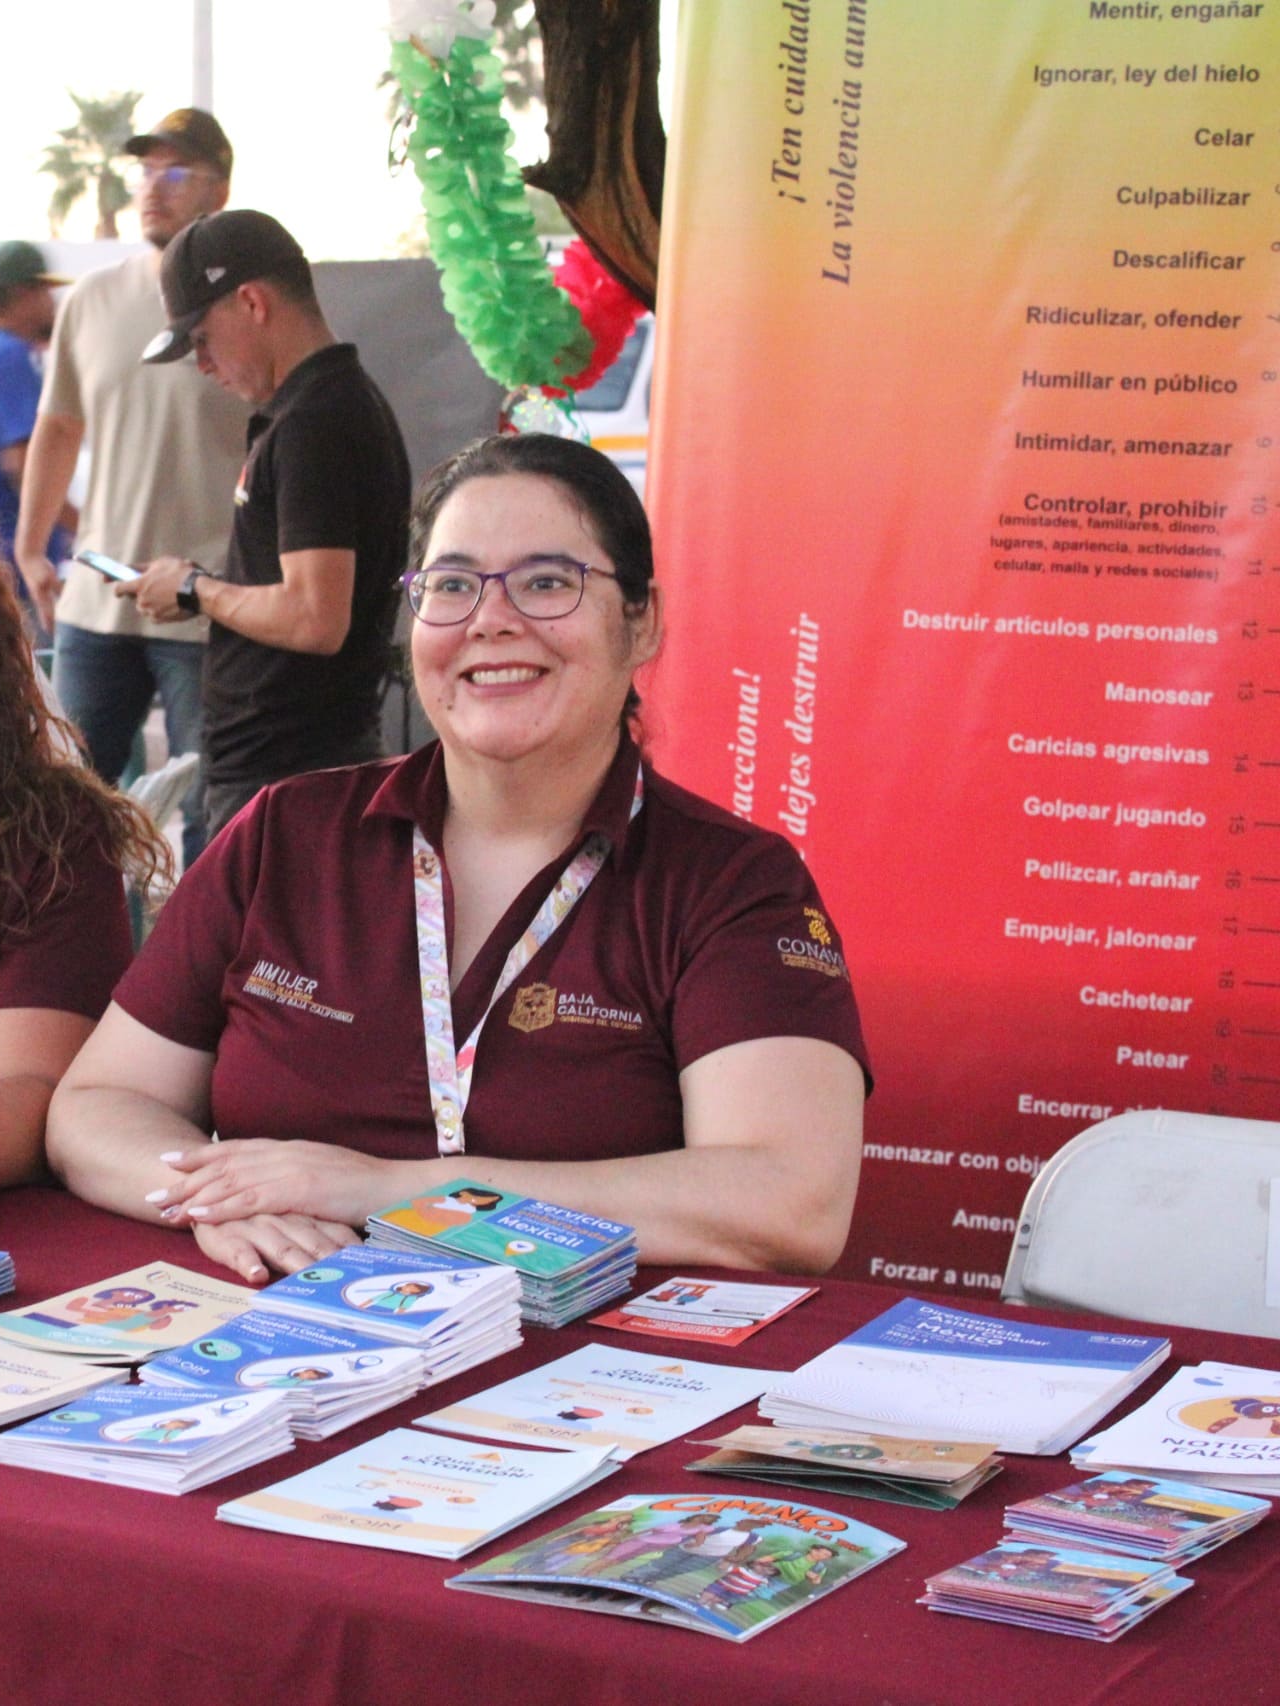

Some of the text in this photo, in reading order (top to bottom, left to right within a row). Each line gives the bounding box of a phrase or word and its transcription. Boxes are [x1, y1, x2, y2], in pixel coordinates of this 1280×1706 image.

[1089, 1, 1264, 23] Mentir, engañar
[1033, 65, 1261, 87] Ignorar, ley del hielo
[771, 0, 810, 204] ¡Ten cuidad
[1194, 128, 1254, 147] Celar
[826, 80, 862, 229] violencia
[1116, 185, 1251, 210] Culpabilizar
[821, 241, 852, 286] La
[1113, 249, 1245, 270] Descalificar
[1026, 306, 1242, 330] Ridiculizar, ofender
[1022, 369, 1238, 397] Humillar en público
[1014, 432, 1233, 457] Intimidar, amenazar
[1023, 493, 1228, 519] Controlar, prohibir
[1095, 565, 1103, 577] y
[1107, 563, 1149, 577] redes
[902, 609, 1219, 644] Destruir artículos personales
[1104, 682, 1214, 706] Manosear
[778, 612, 820, 836] dejes destruir
[1007, 733, 1210, 764] Caricias agresivas
[1023, 796, 1207, 828] Golpear jugando
[1024, 858, 1201, 890] Pellizcar, arañar
[1004, 917, 1198, 951] Empujar, jalonear
[251, 959, 319, 994] INMUJER
[558, 992, 595, 1006] BAJA
[1079, 986, 1194, 1012] Cachetear
[557, 1005, 643, 1024] CALIFORNIA
[1115, 1046, 1190, 1069] Patear
[959, 1153, 999, 1170] con
[534, 1201, 624, 1234] Servicios
[497, 1215, 584, 1248] Mexicali
[870, 1256, 1002, 1289] Forzar a una
[915, 1321, 1004, 1347] México
